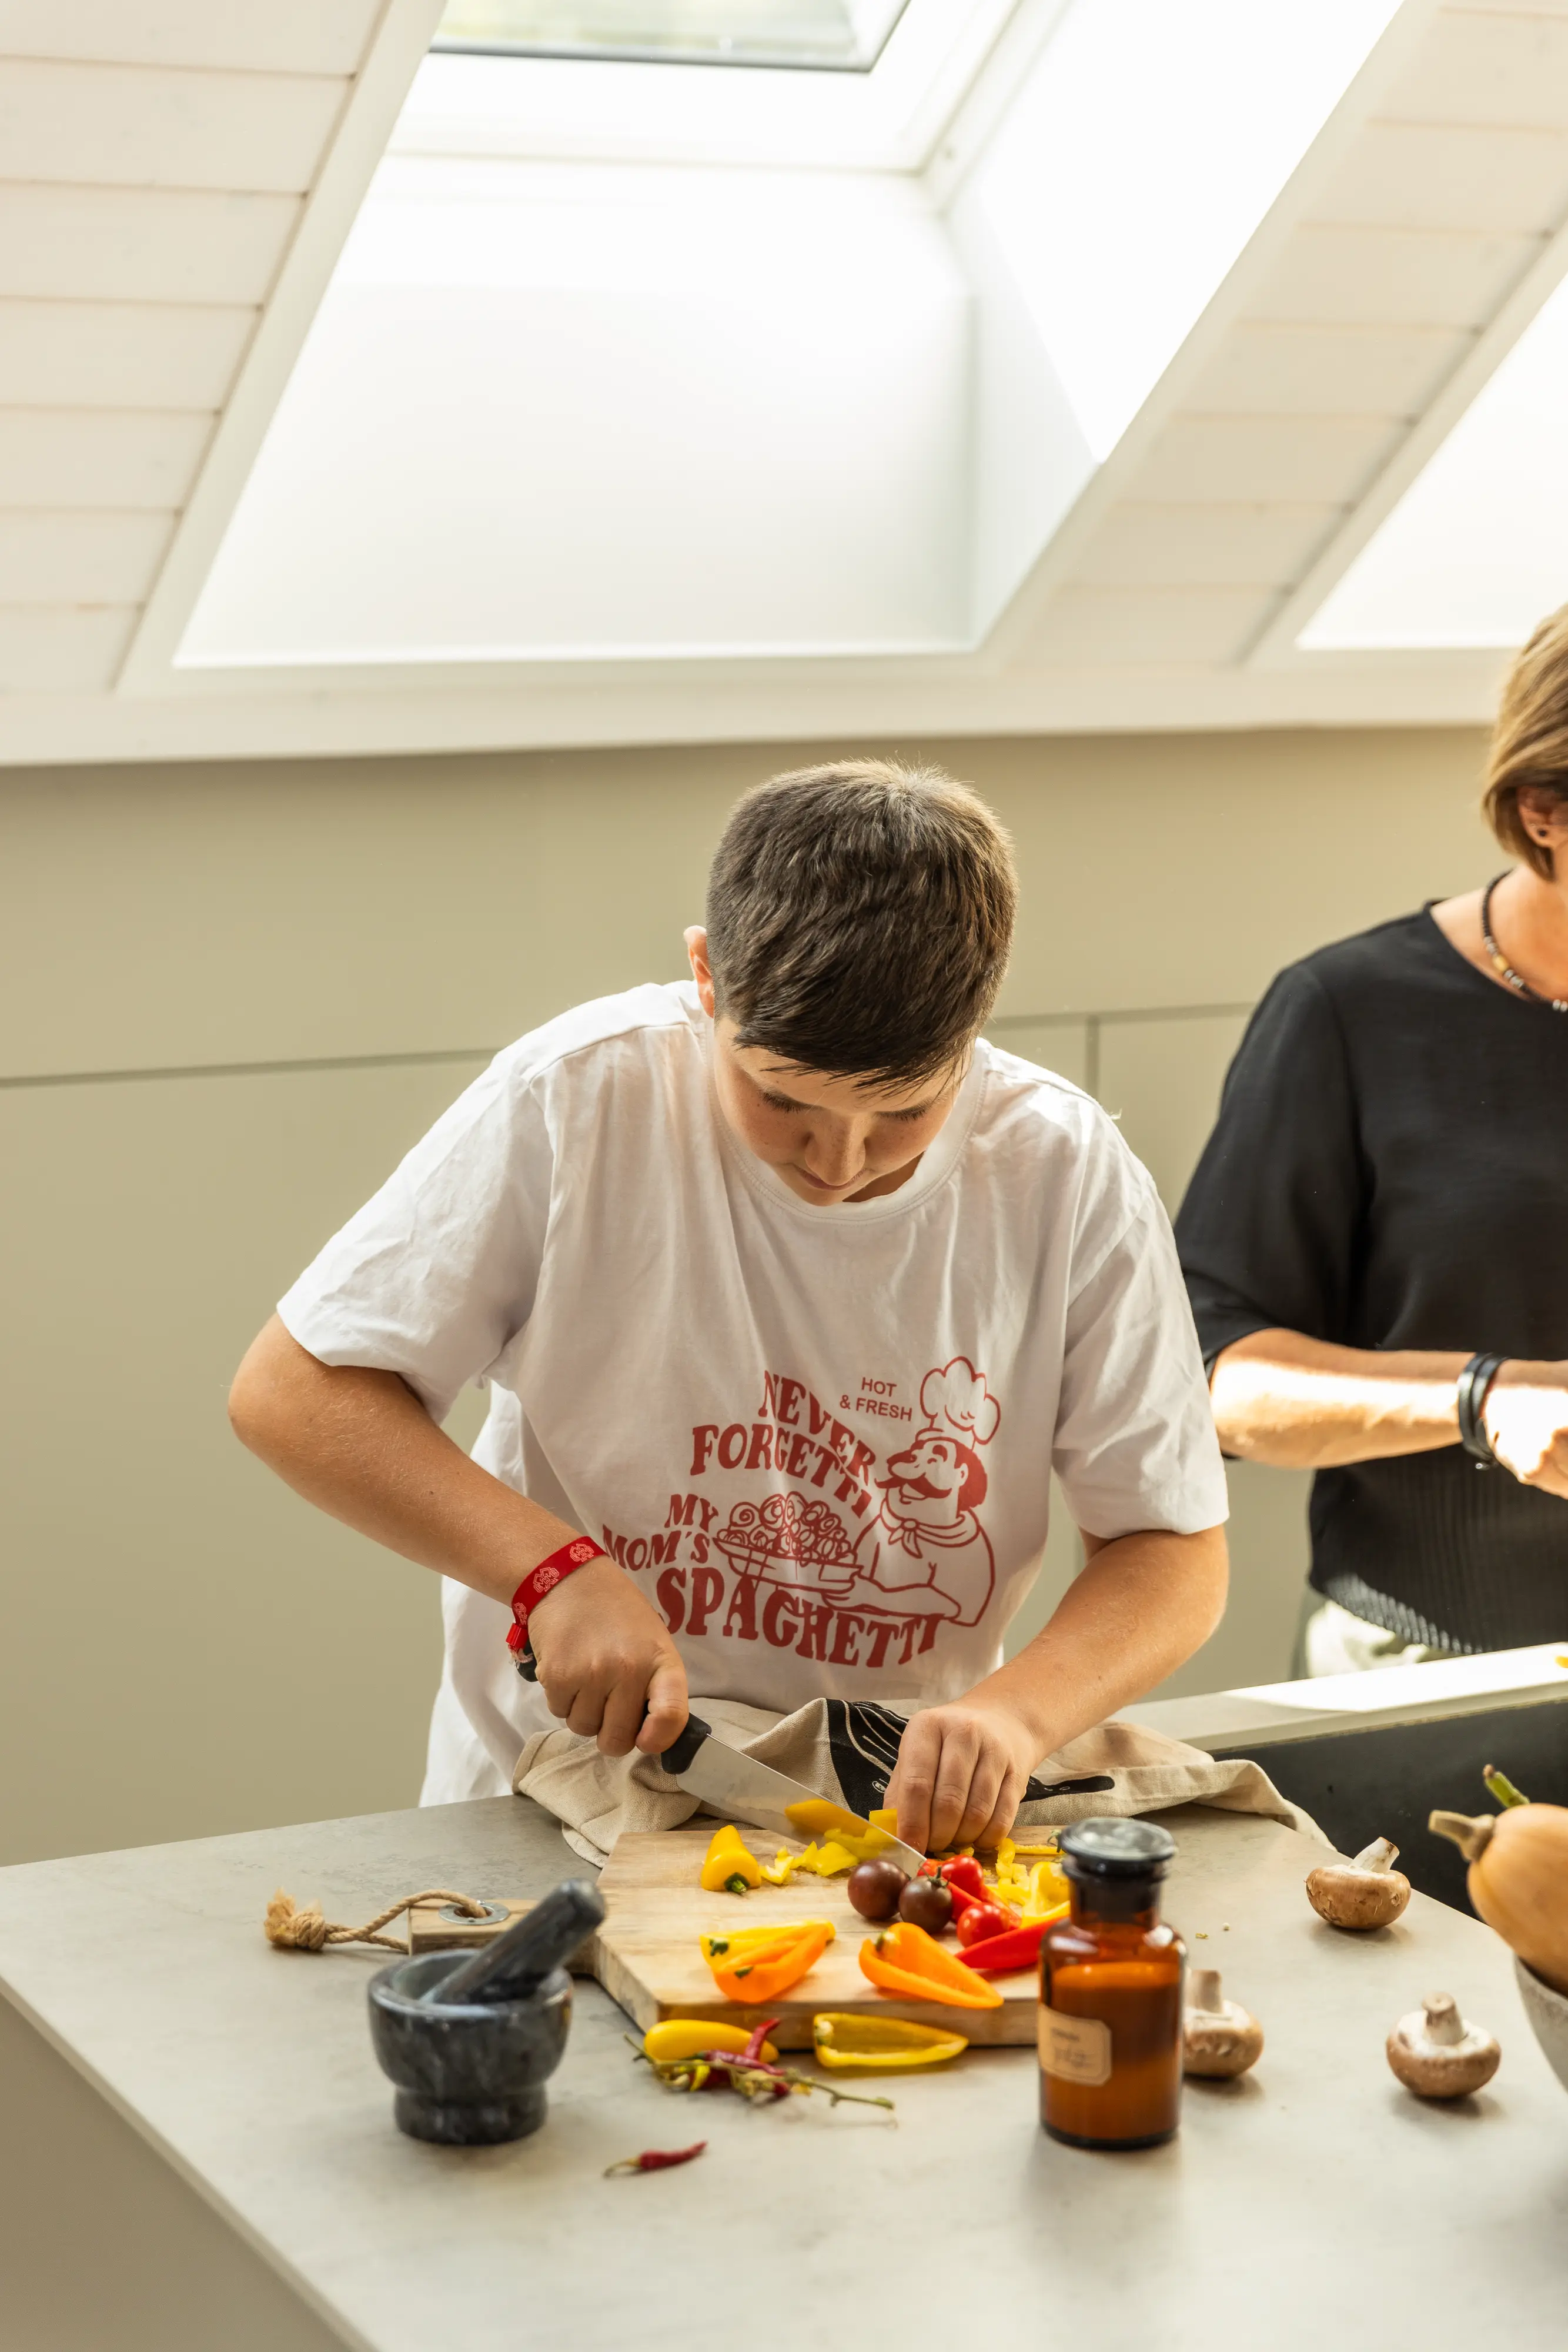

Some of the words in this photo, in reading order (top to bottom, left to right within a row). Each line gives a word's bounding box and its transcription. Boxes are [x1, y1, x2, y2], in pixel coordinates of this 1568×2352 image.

[840, 1395, 851, 1410] &
[856, 1397, 913, 1421] FRESH
[861, 1377, 897, 1397] HOT
[758, 1370, 876, 1486] NEVER
[690, 1423, 872, 1519] FORGETTI
[664, 1494, 719, 1533] MY
[603, 1524, 710, 1571] MOM'S
[656, 1567, 945, 1668] SPAGHETTI
